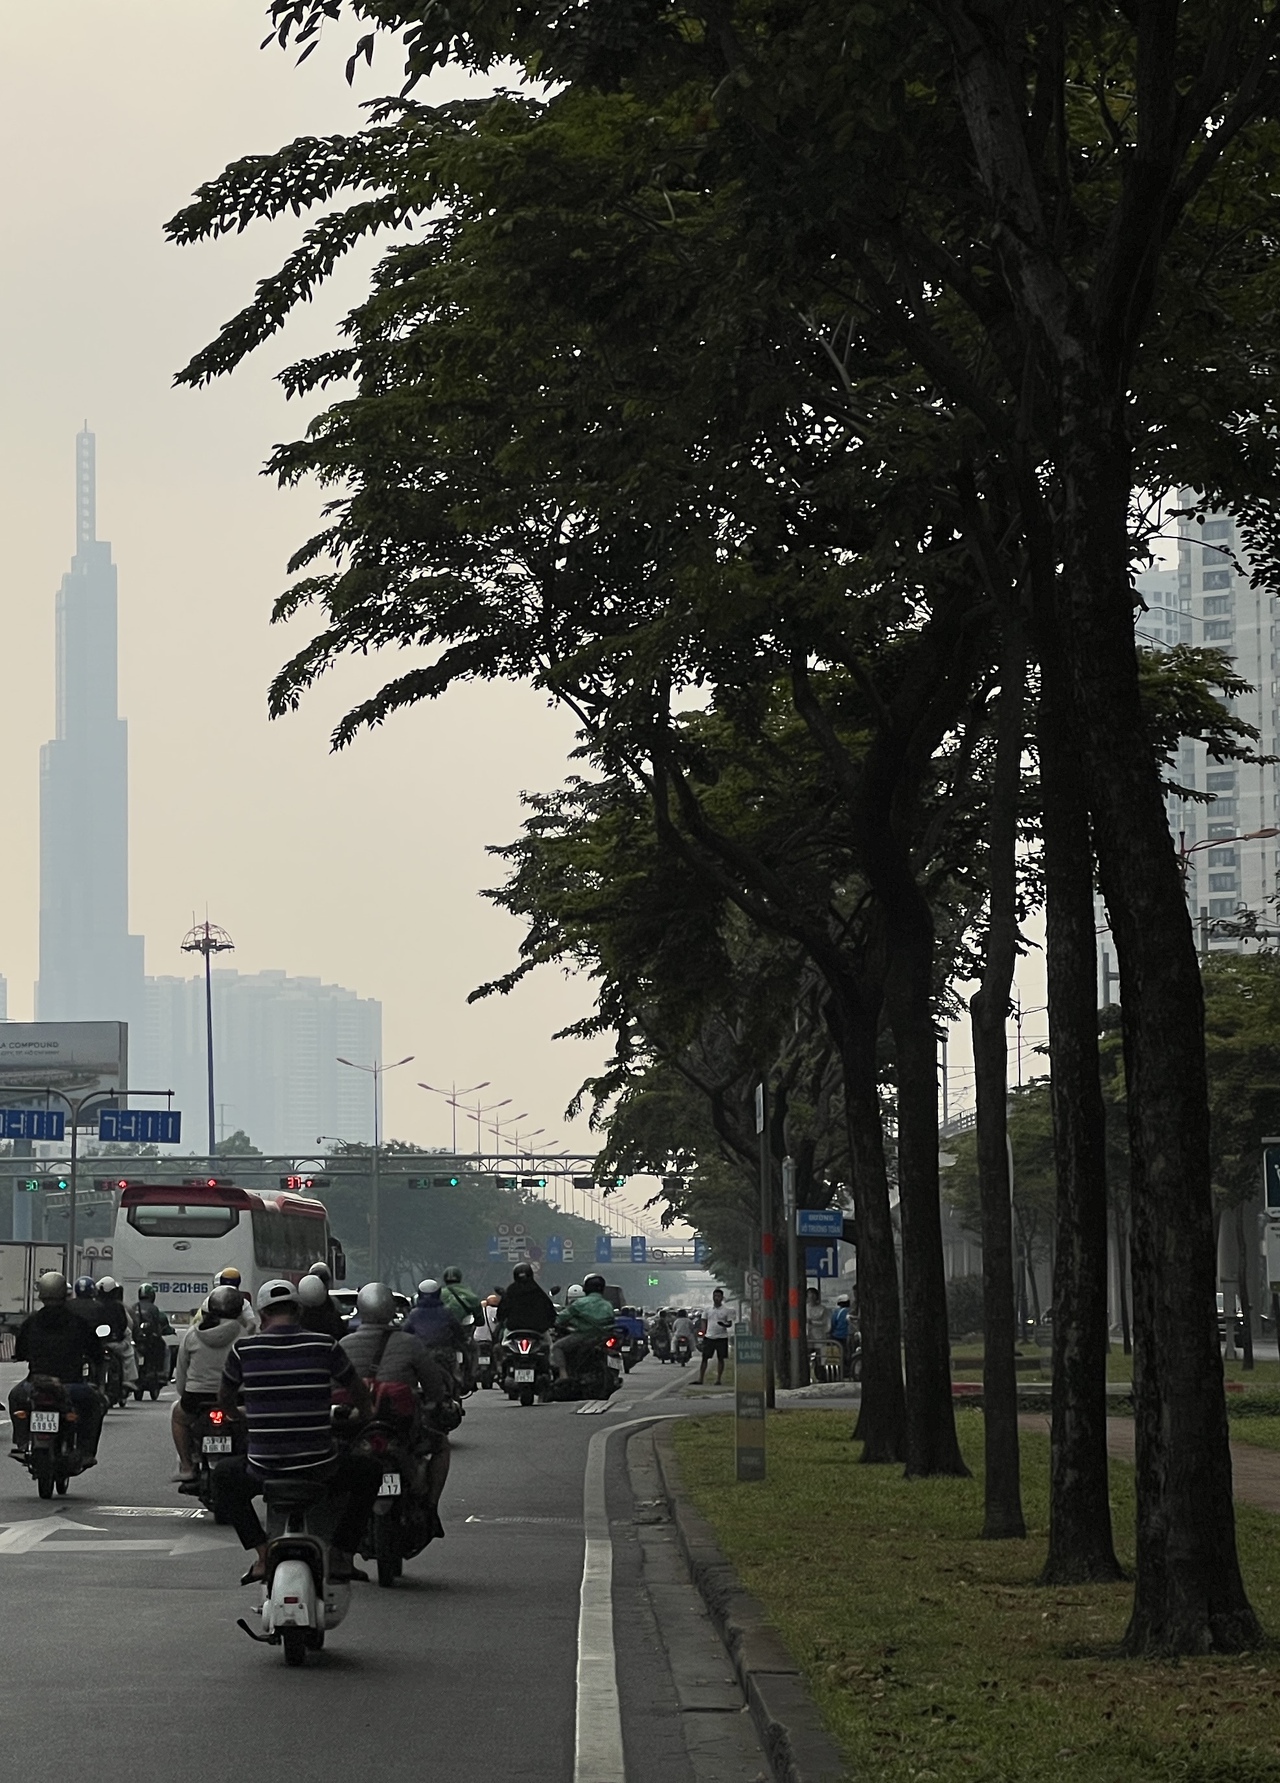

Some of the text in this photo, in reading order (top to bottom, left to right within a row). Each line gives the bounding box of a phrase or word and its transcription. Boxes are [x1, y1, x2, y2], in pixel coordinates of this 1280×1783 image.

[8, 1041, 59, 1049] COMPOUND
[25, 1180, 39, 1192] 30
[286, 1176, 300, 1189] 37
[35, 1413, 55, 1422] 59-L2
